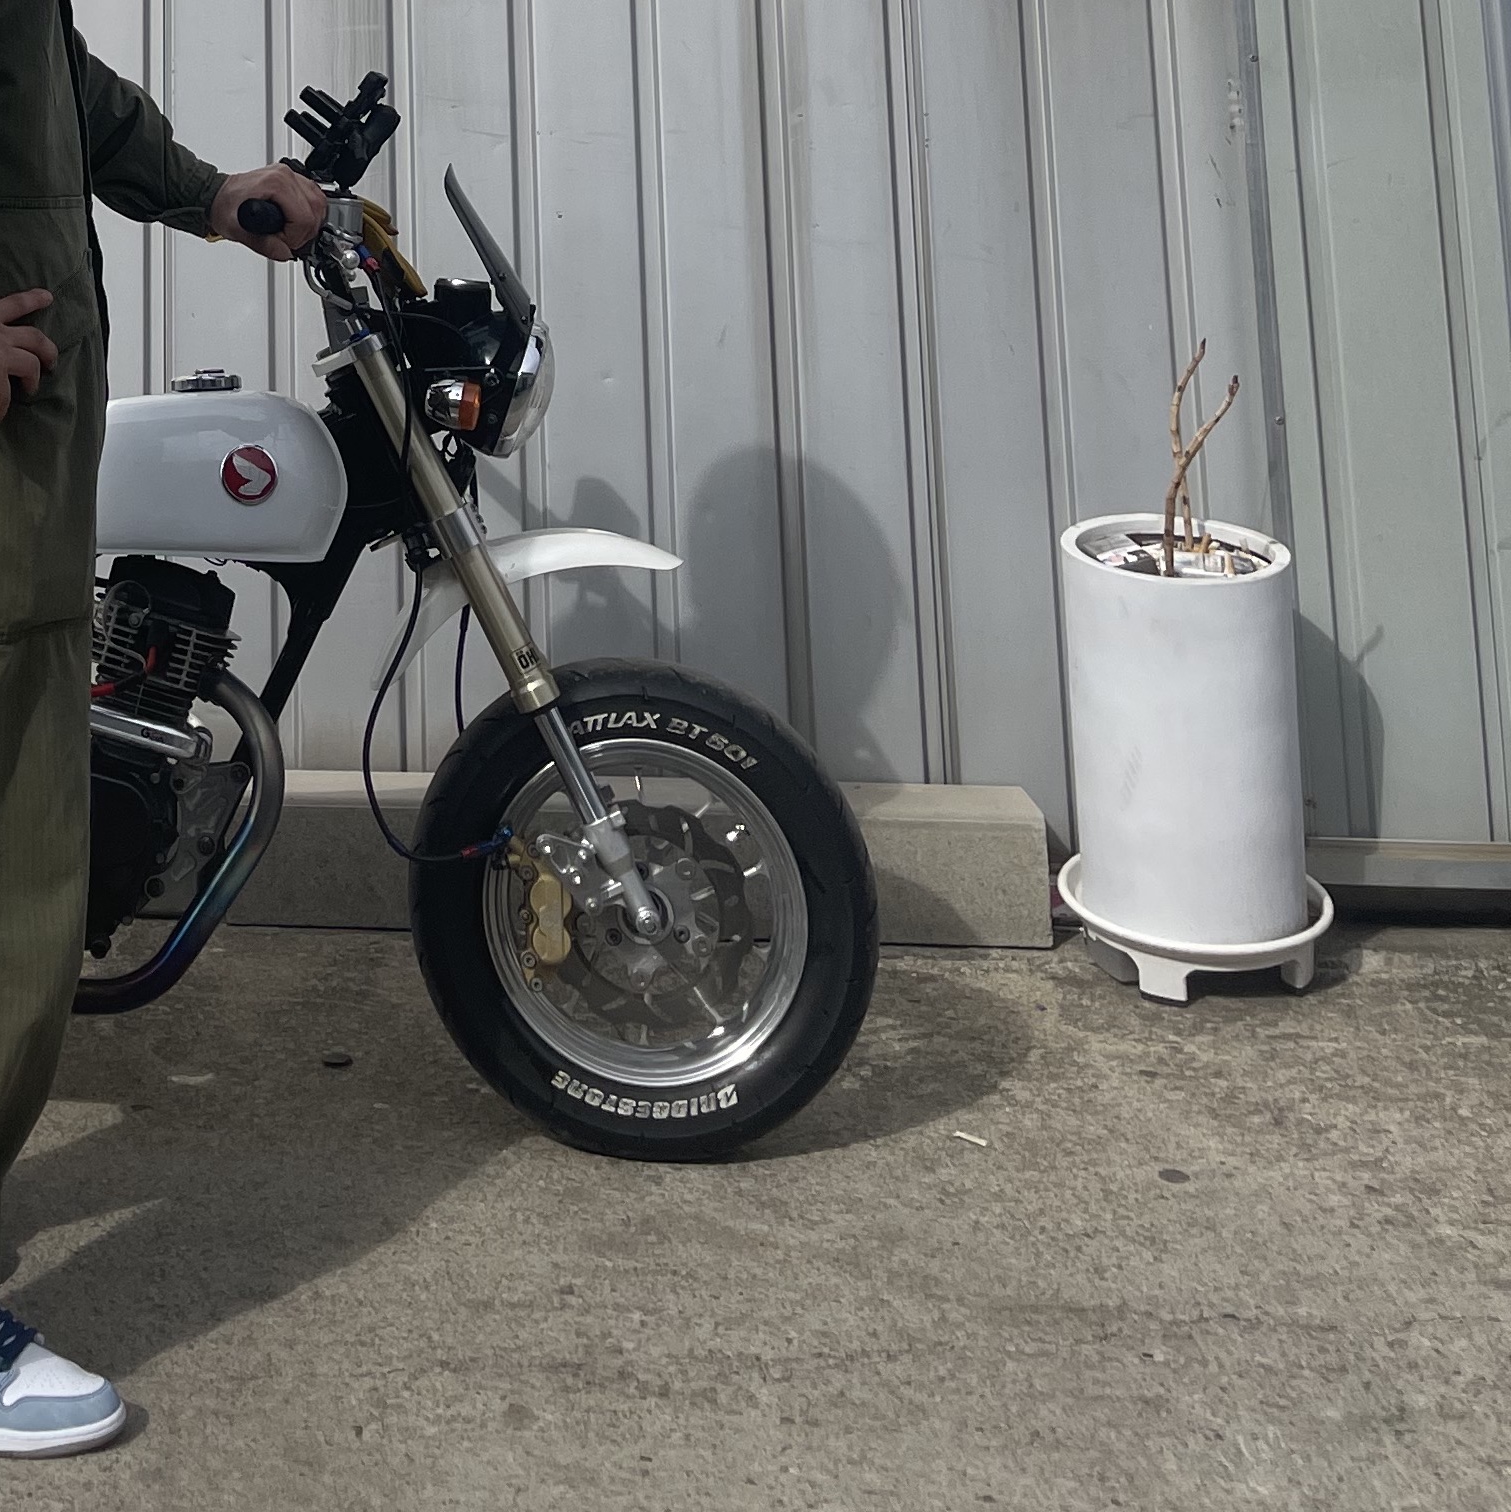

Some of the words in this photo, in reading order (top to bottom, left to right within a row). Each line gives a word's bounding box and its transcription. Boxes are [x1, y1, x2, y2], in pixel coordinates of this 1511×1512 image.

[569, 711, 661, 735] ATTLAX
[666, 717, 709, 740] BT
[550, 1070, 739, 1119] BRIDGESTONE
